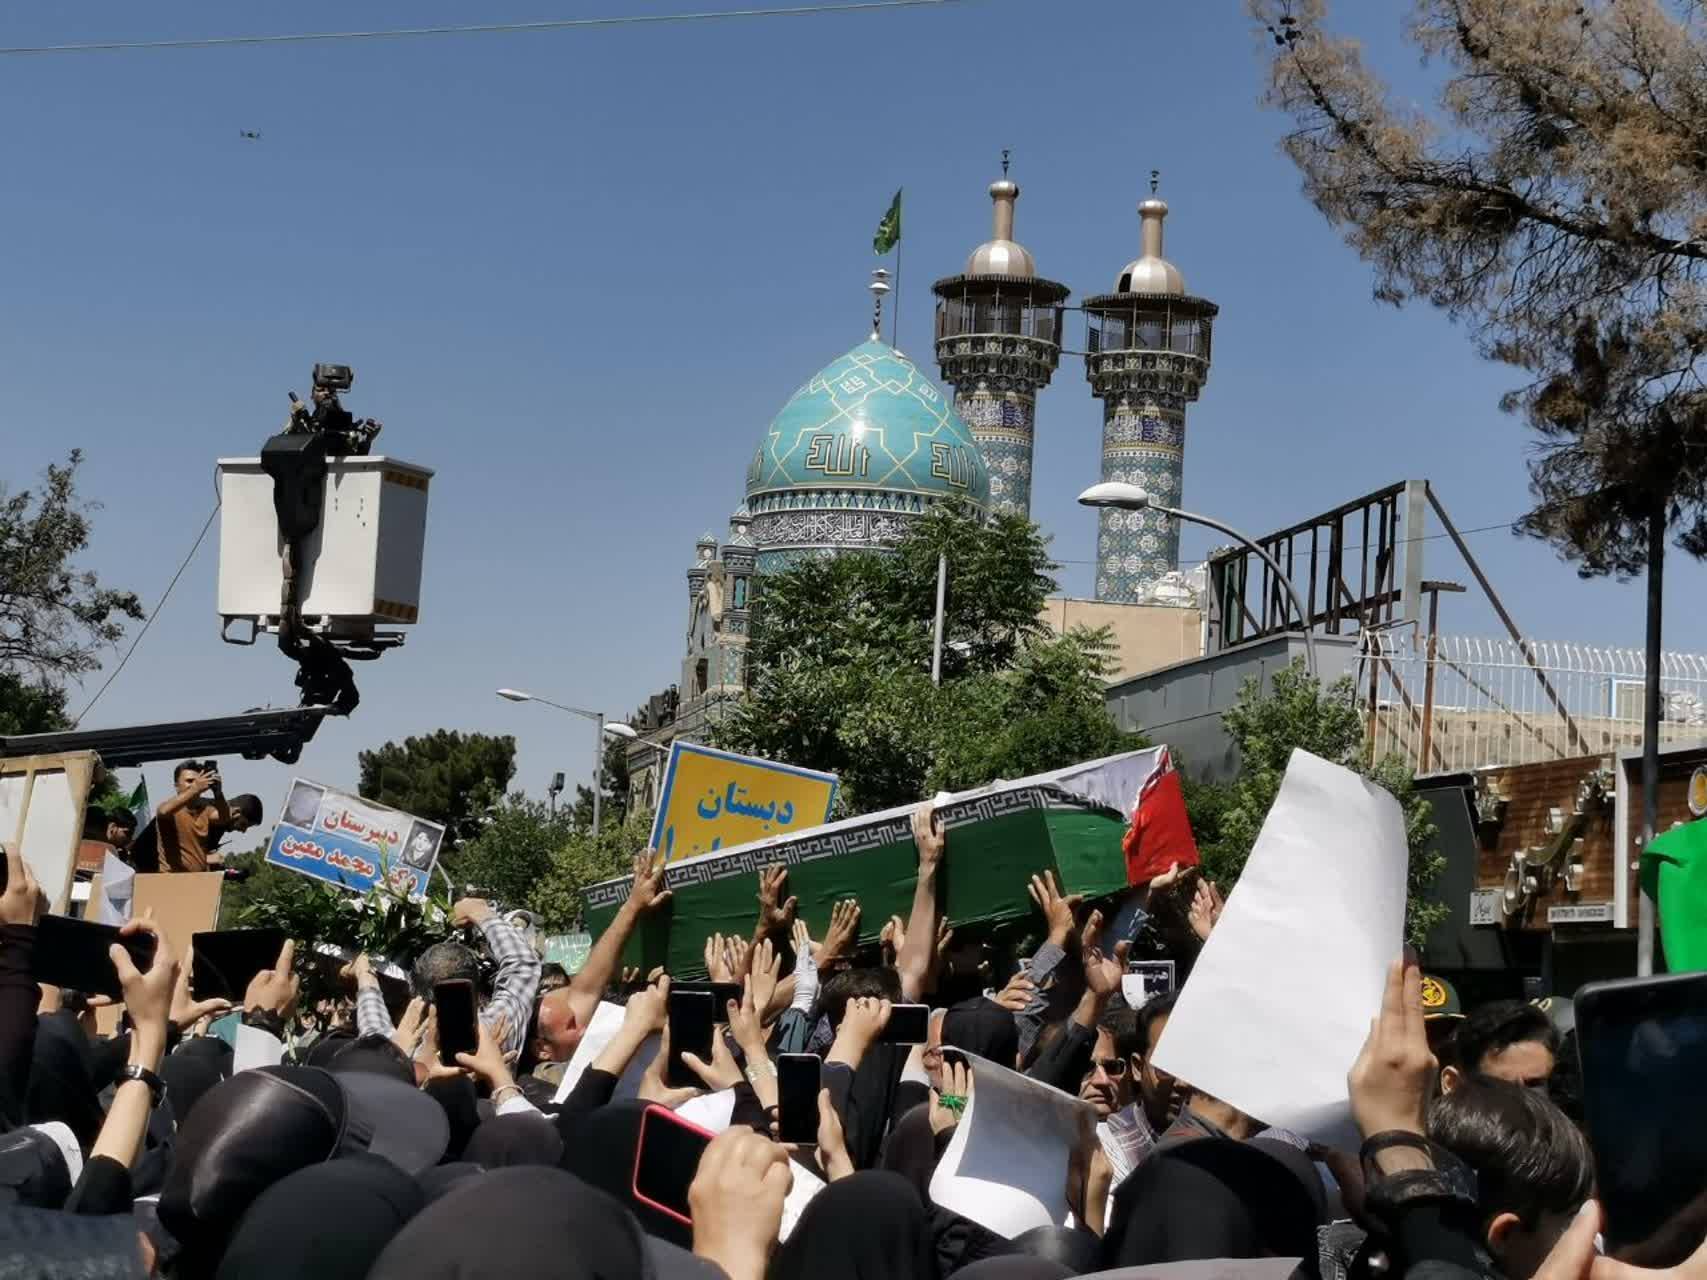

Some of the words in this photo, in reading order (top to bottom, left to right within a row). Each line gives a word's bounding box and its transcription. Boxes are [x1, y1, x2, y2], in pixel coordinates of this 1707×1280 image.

[697, 781, 794, 830] دبستان
[323, 810, 399, 845] دبیرستان
[280, 835, 324, 860] معین
[326, 848, 376, 877] محمد
